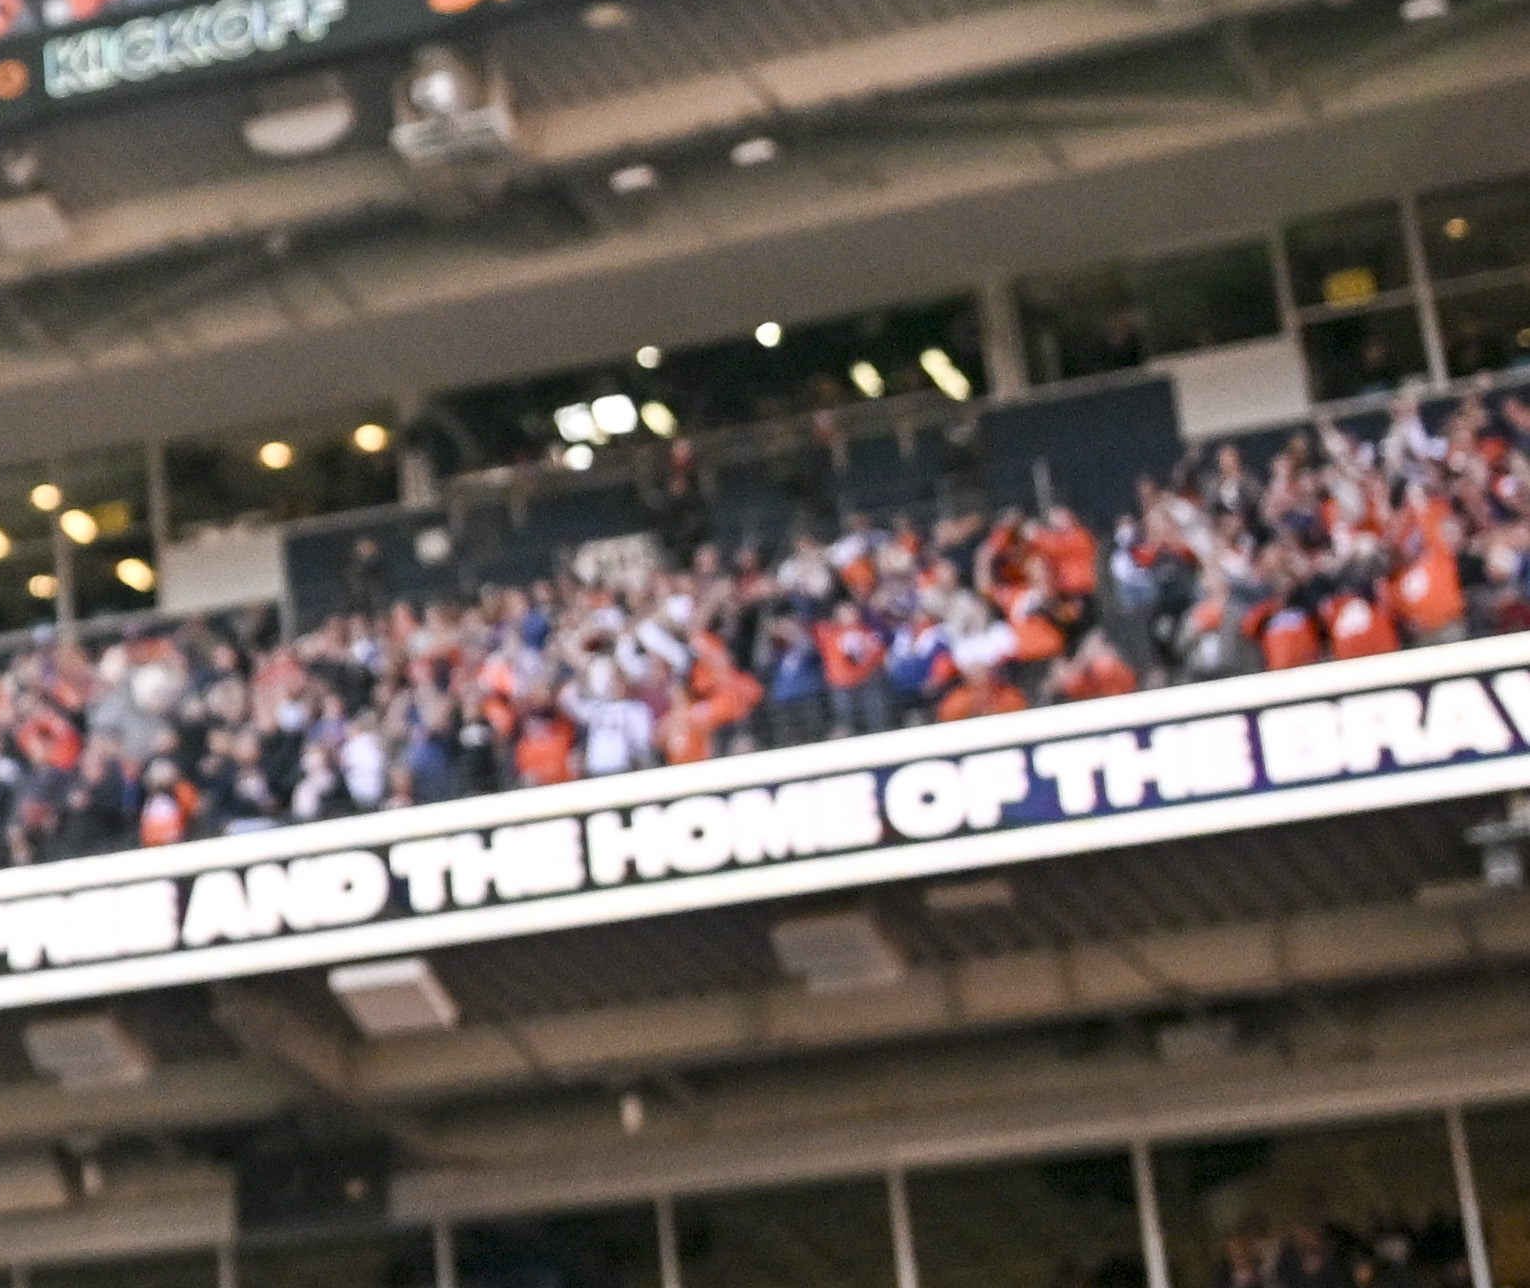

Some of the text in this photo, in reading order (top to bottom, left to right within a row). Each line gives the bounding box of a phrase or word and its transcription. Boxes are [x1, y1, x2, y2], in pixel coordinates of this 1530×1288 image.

[182, 849, 390, 947] AND
[388, 817, 584, 912] THE
[586, 771, 883, 886] HOME
[884, 749, 1030, 839] OF
[1033, 713, 1256, 815] THE
